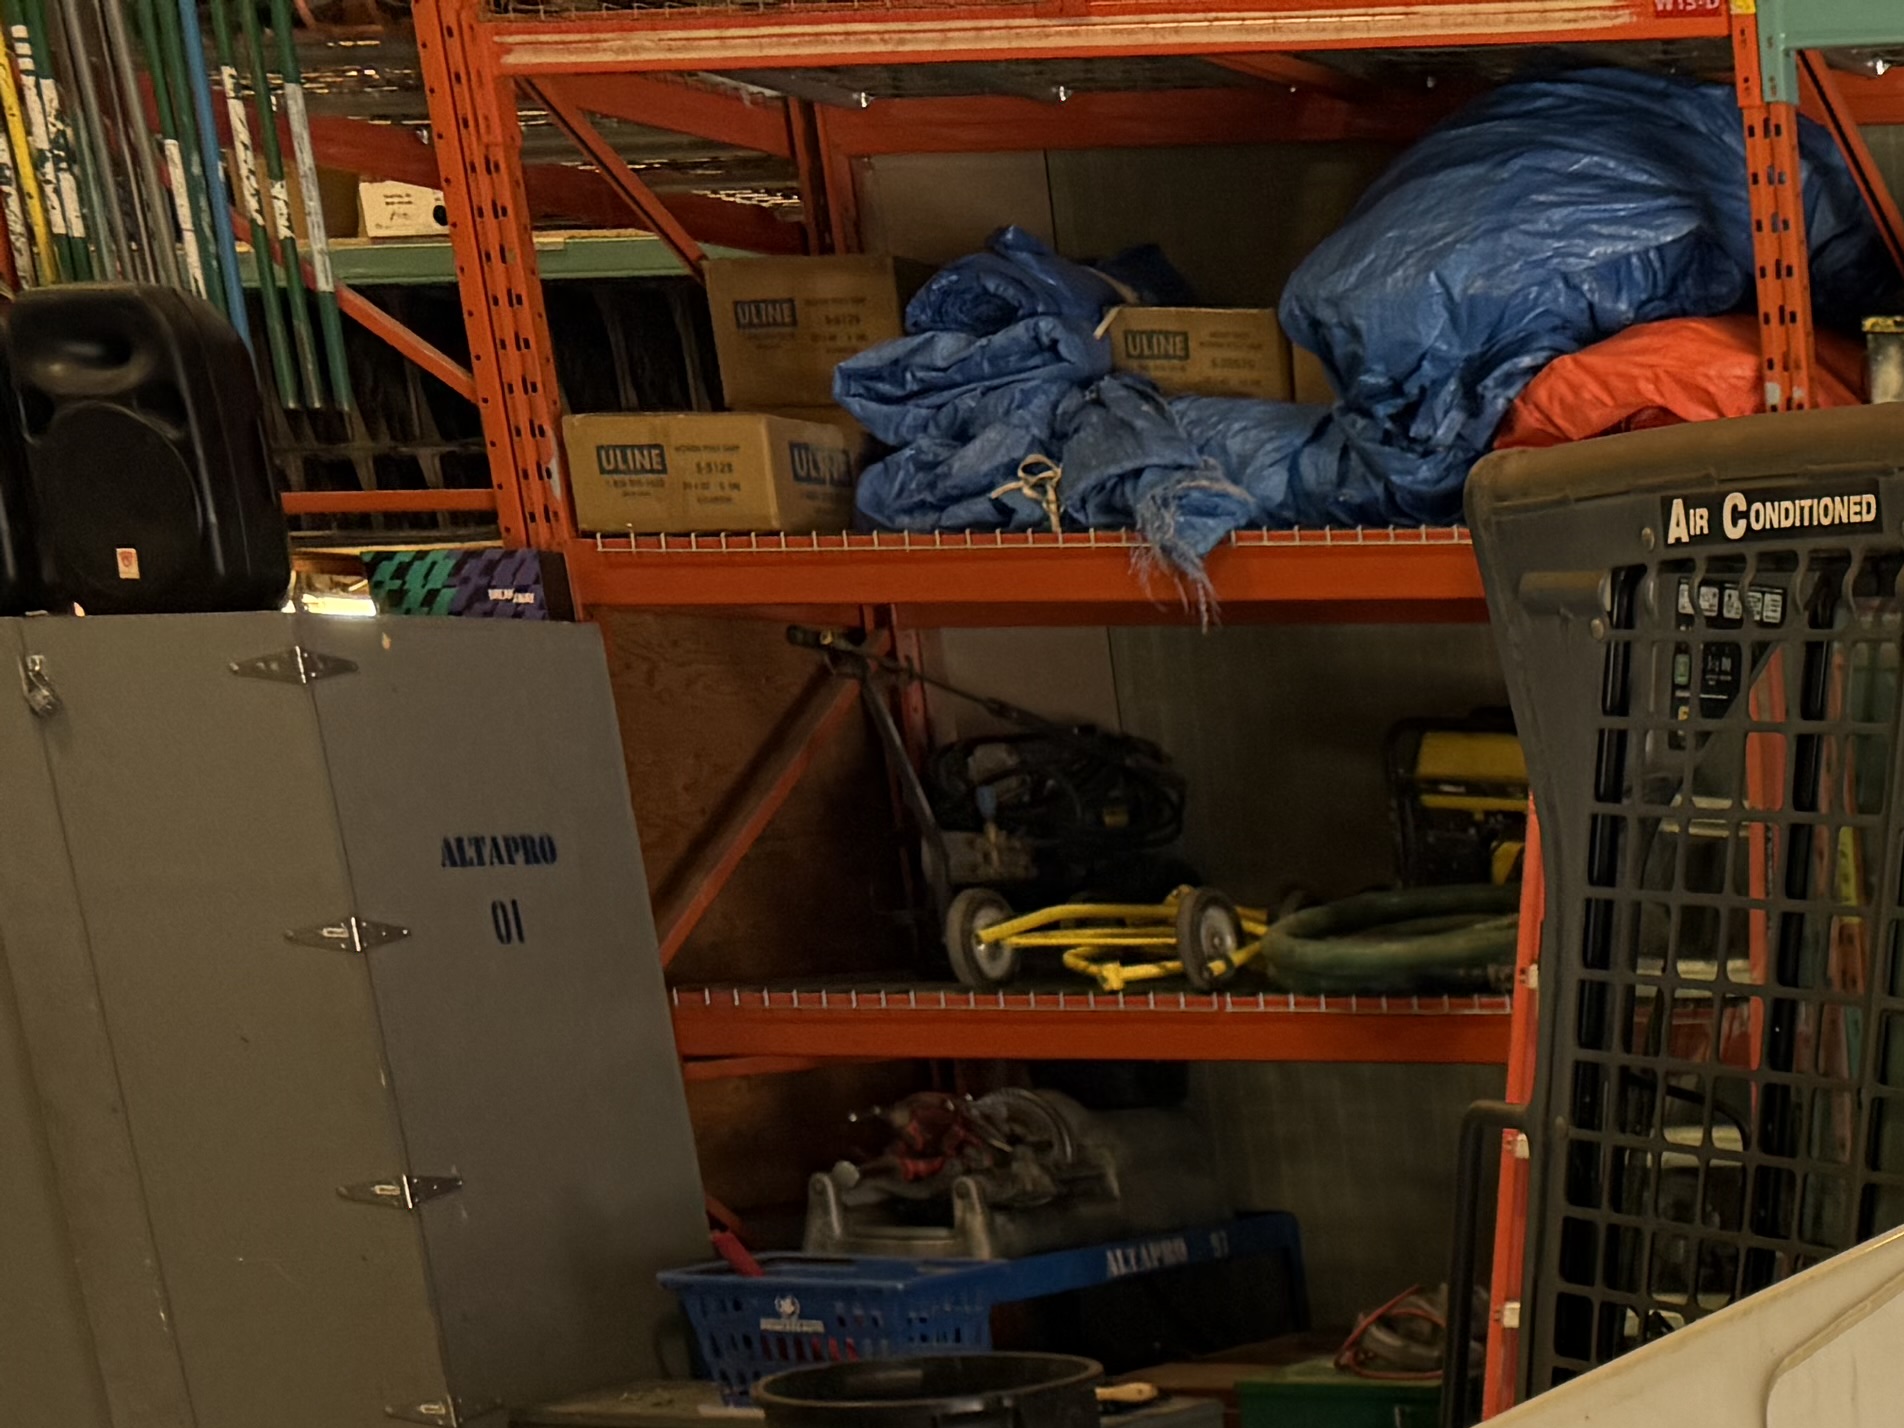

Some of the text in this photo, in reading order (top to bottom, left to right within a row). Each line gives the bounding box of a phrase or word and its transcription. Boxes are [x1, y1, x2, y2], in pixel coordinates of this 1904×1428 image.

[737, 302, 794, 326] ULINE
[1127, 333, 1186, 357] ULINE
[601, 447, 664, 471] ULINE
[441, 834, 557, 867] ALTAPRO
